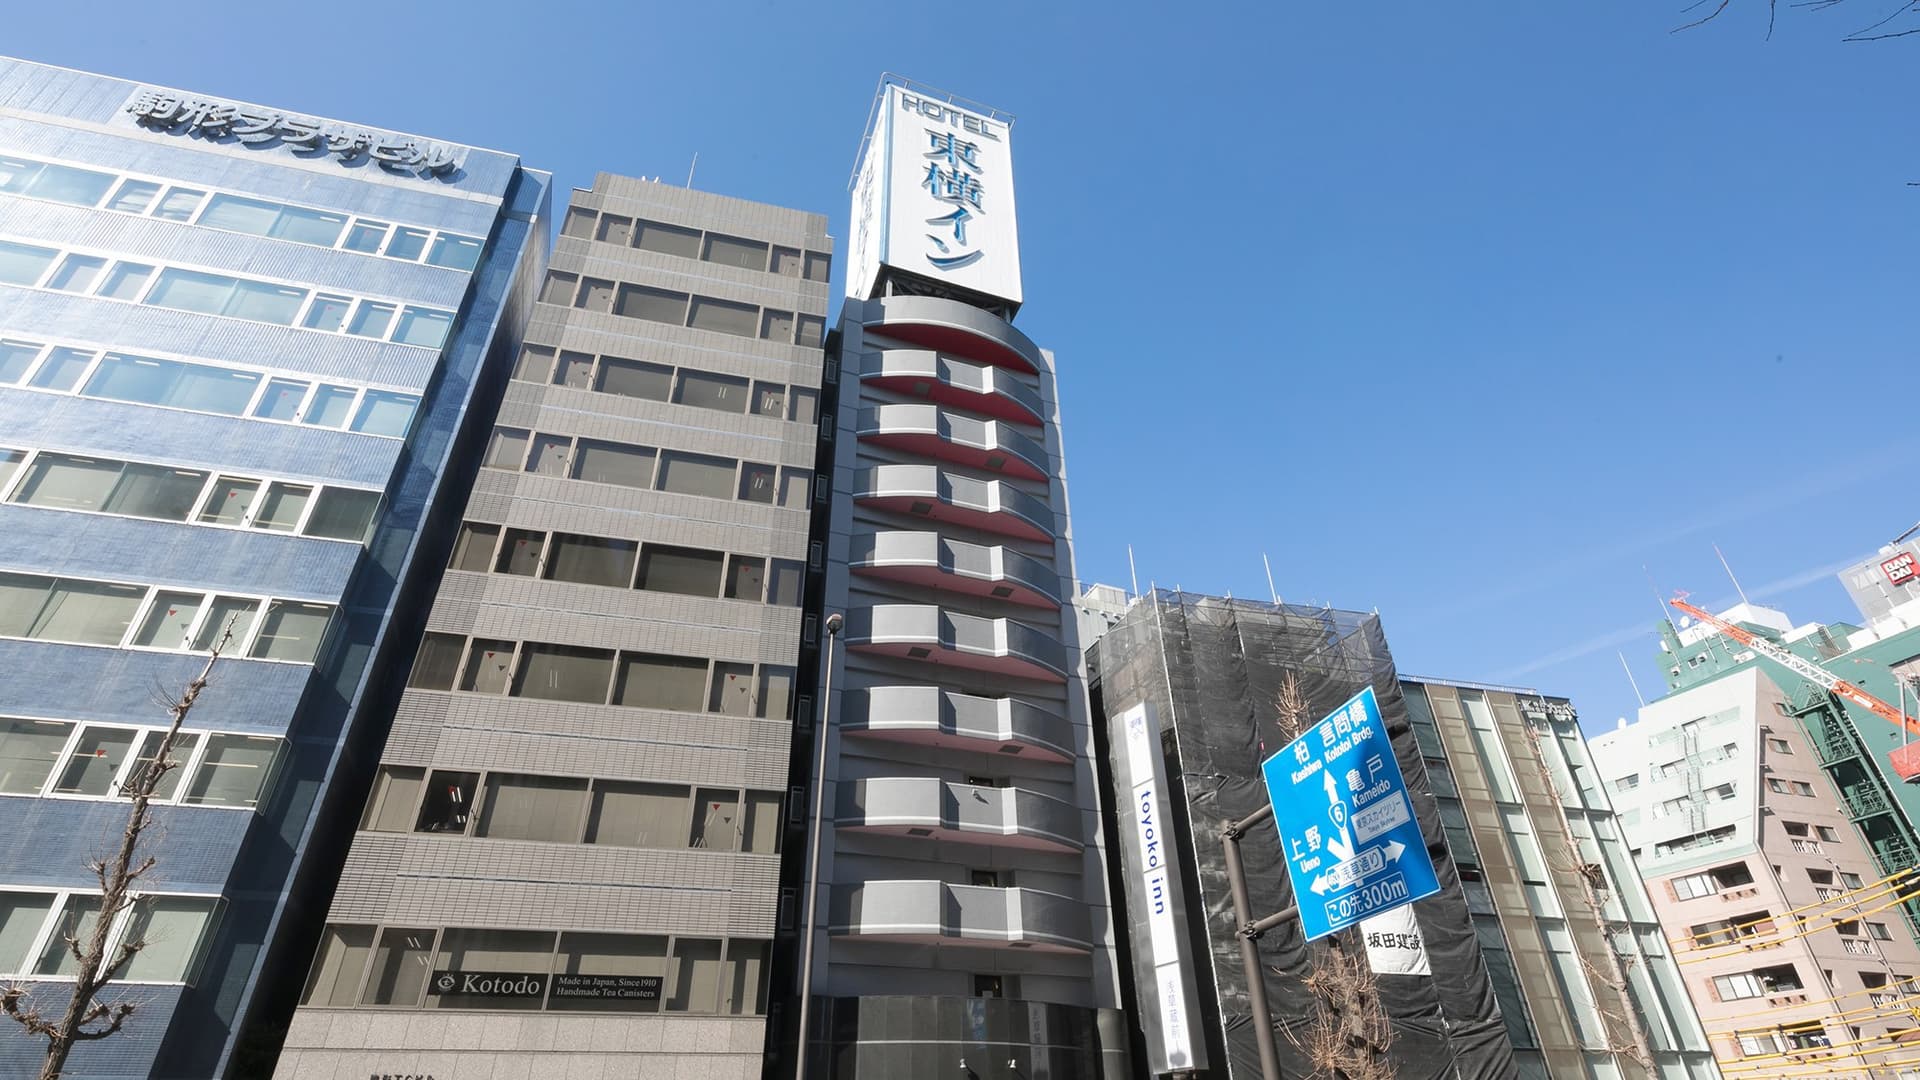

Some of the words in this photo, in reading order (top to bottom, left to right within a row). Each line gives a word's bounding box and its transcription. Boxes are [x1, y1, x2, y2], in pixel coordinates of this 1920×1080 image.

[128, 91, 455, 168] 駒形プラザビル
[902, 92, 1000, 139] HOTEL
[922, 127, 985, 267] 東横イン
[1883, 554, 1913, 573] BAN
[1294, 740, 1310, 764] 柏
[1320, 700, 1368, 747] 言問橋
[1291, 759, 1323, 785] Kashiwa
[1346, 754, 1383, 792] 亀戸
[1352, 779, 1391, 808] Kameido
[1334, 805, 1343, 822] 6
[1141, 790, 1158, 868] toyoko
[1152, 877, 1164, 915] inn
[1291, 825, 1321, 862] 上野
[1300, 856, 1321, 874] Ueno
[1328, 880, 1406, 922] この先300m
[461, 974, 540, 995] Kotodo
[557, 987, 600, 997] Handmade
[602, 988, 616, 997] Tea
[617, 988, 655, 998] Canisters
[558, 977, 581, 986] Made
[582, 977, 592, 986] in
[618, 978, 640, 987] Since
